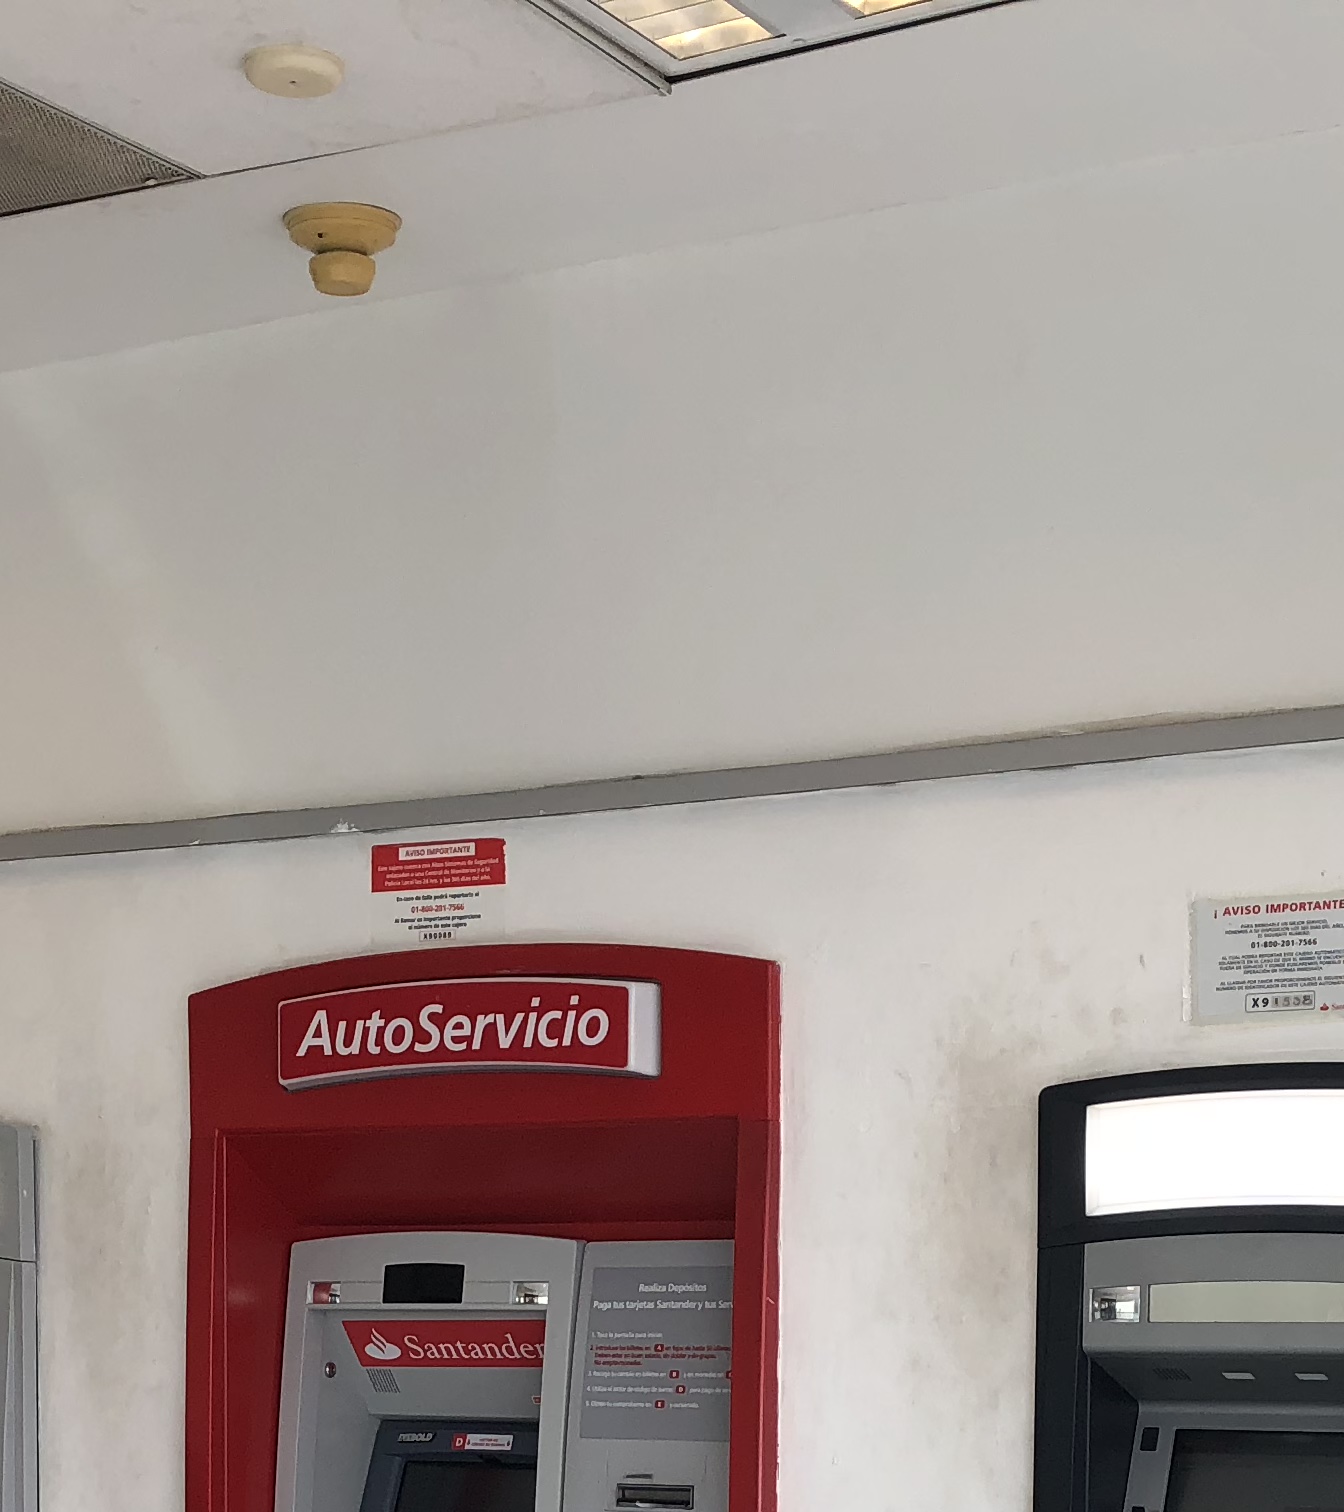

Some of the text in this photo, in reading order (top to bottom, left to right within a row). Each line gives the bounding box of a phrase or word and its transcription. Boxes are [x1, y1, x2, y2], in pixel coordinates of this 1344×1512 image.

[427, 846, 470, 855] IMPORTANTE
[1223, 904, 1261, 916] AVISO
[1251, 938, 1317, 948] 01-800-201-7566
[296, 994, 610, 1057] AutoServicio
[593, 1301, 612, 1310] Paga
[626, 1300, 654, 1310] tarjetas
[656, 1300, 696, 1308] Santander
[404, 1333, 544, 1359] Santander
[456, 1438, 463, 1446] D
